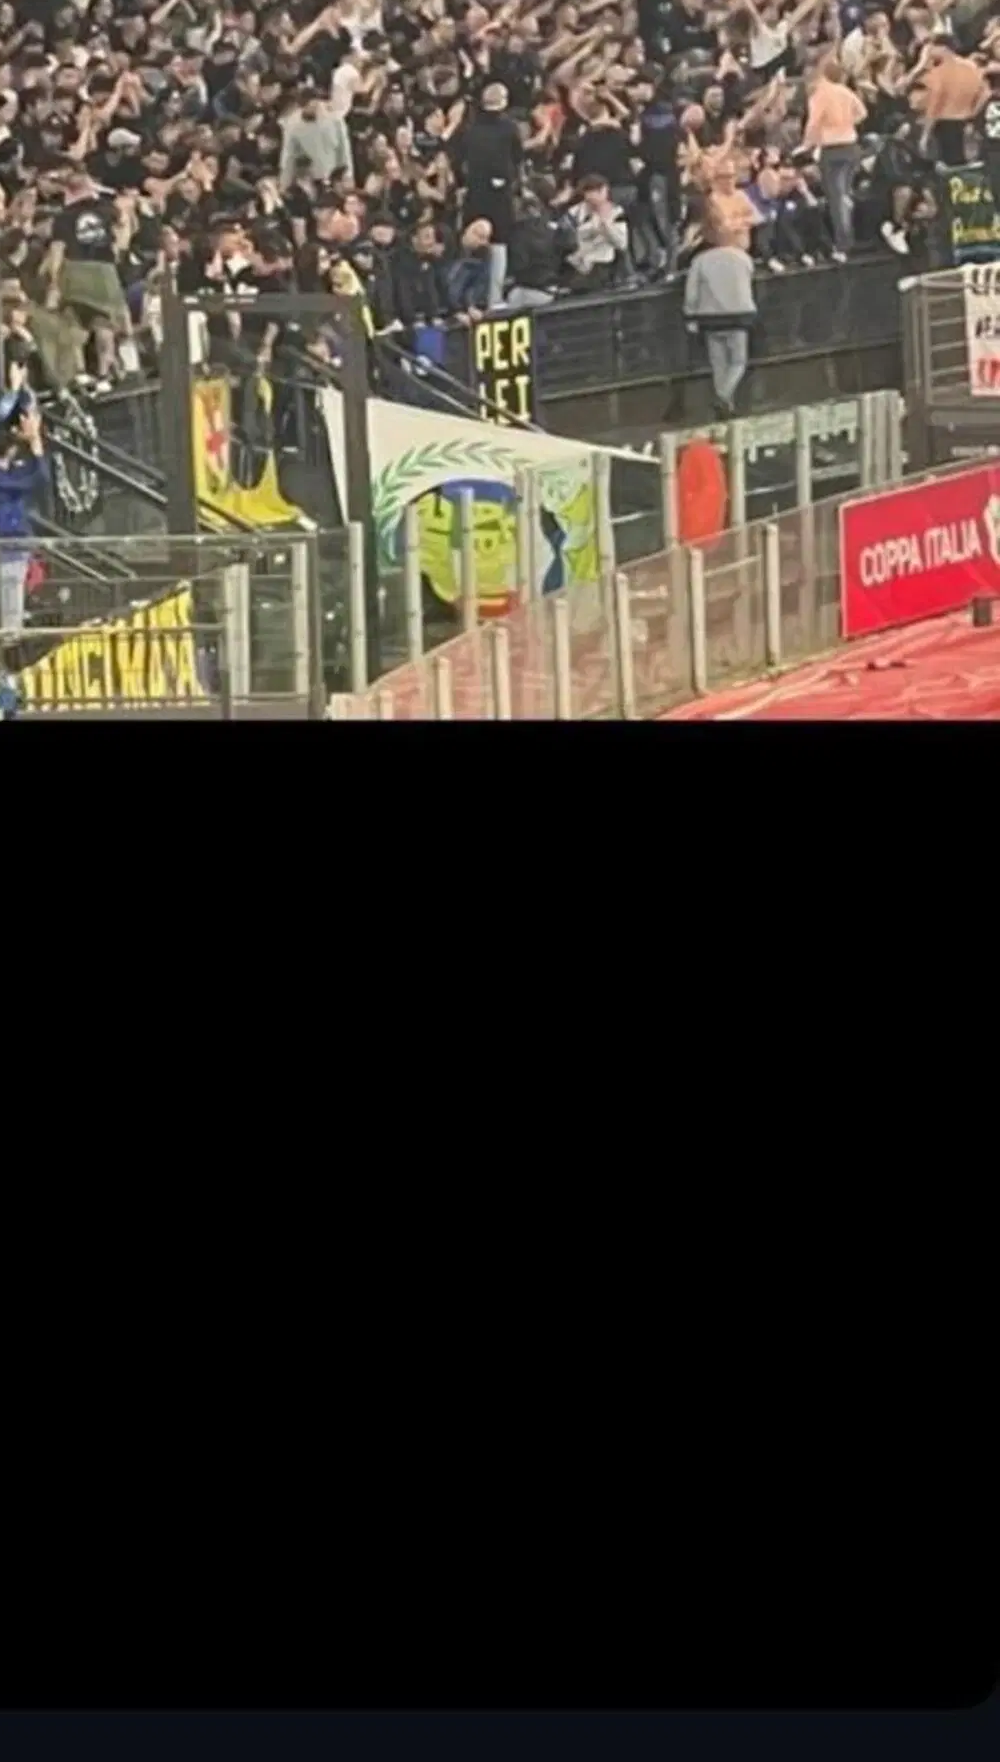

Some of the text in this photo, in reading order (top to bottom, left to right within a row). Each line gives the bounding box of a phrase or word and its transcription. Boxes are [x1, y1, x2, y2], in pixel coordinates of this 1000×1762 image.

[475, 317, 531, 372] PER
[860, 518, 982, 586] COPPA ITALIA
